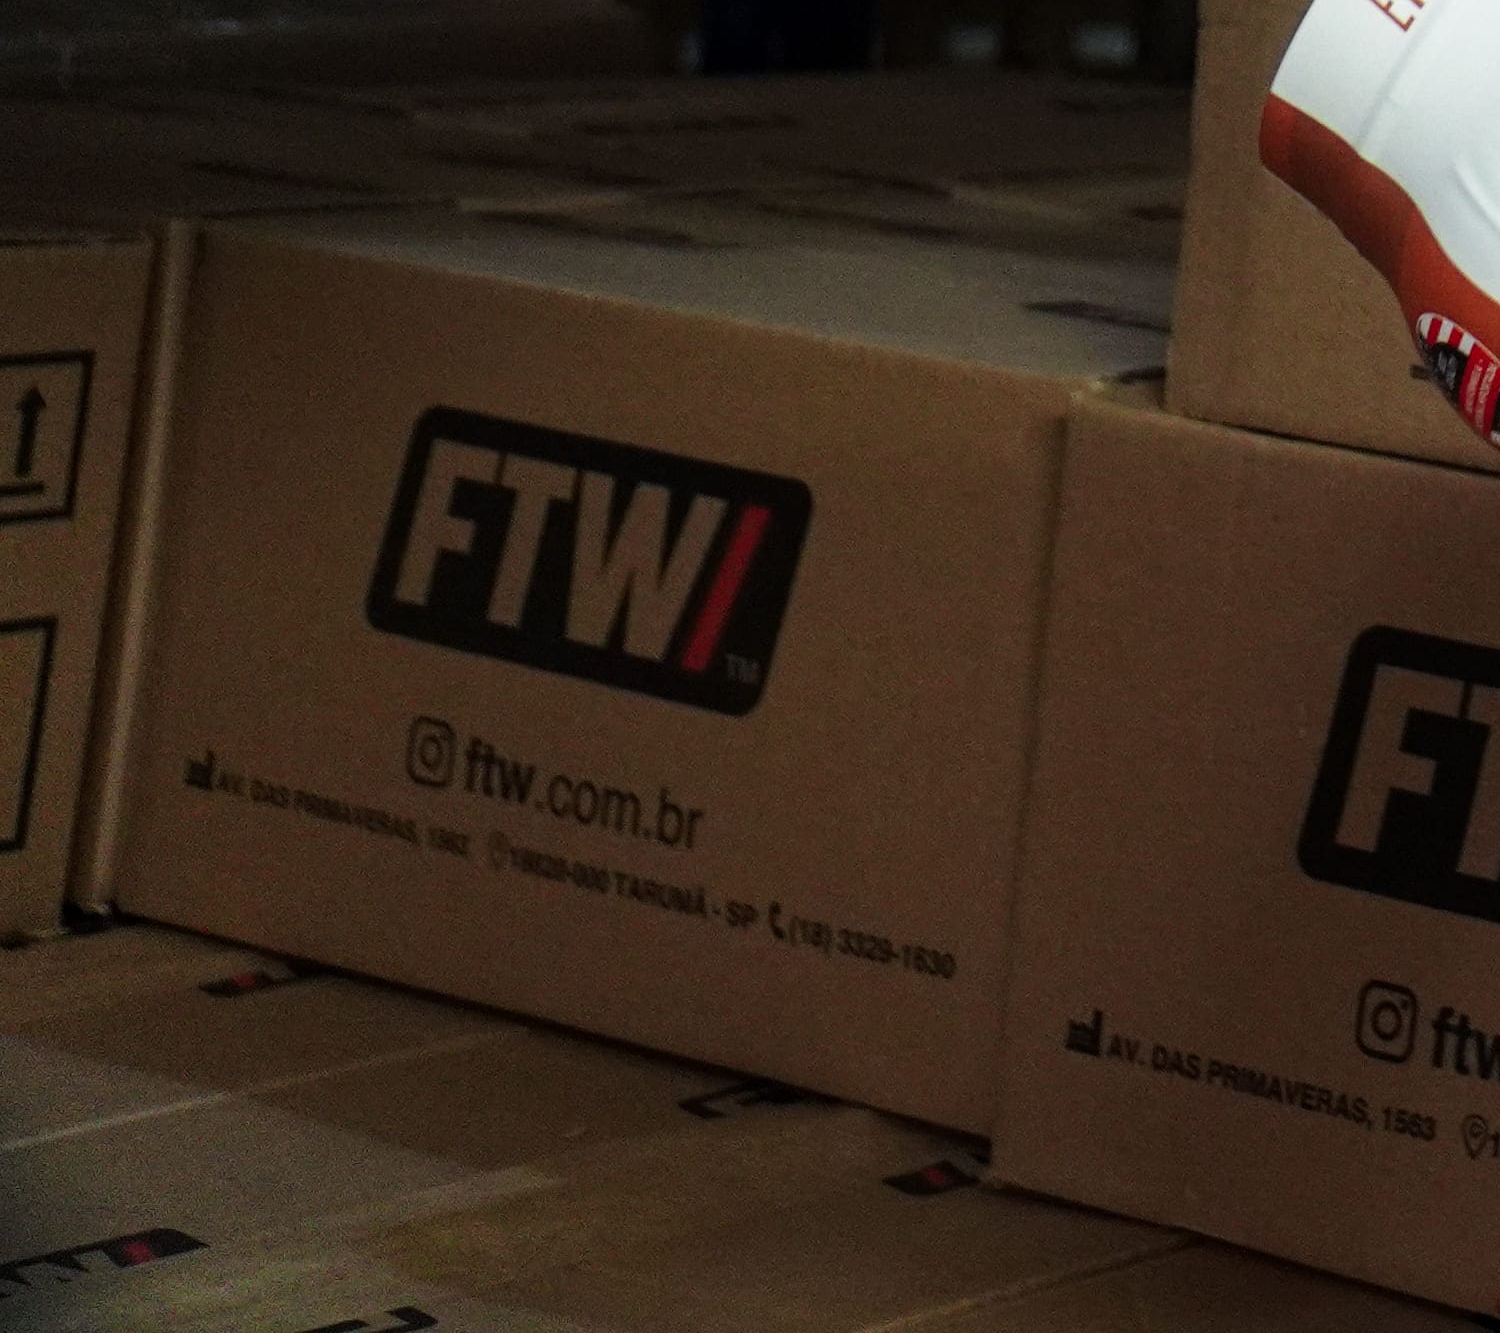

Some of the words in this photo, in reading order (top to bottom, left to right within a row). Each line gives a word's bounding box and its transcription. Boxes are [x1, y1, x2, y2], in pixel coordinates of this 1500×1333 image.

[463, 737, 703, 850] ftw.com.br
[1105, 1033, 1145, 1067] AV.
[1151, 1043, 1202, 1082] DAS
